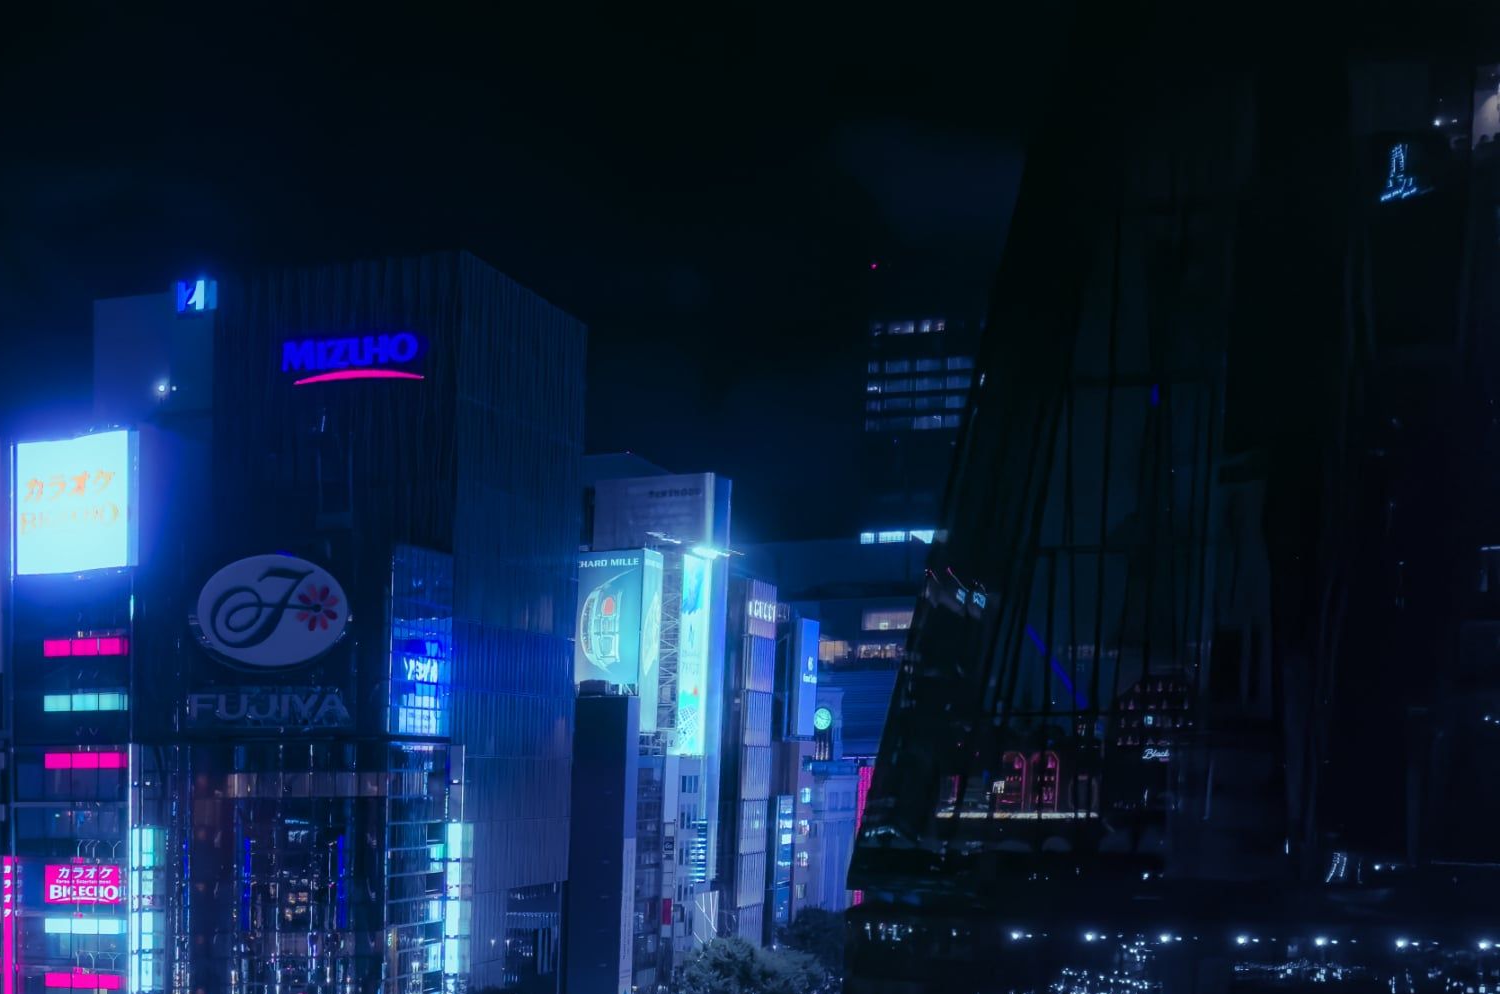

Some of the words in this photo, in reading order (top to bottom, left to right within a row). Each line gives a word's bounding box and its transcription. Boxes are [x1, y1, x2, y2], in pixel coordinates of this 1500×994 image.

[282, 332, 419, 371] MIZUHO
[22, 468, 116, 502] カラオケ
[610, 557, 640, 567] MILLE
[187, 692, 352, 721] FUJIYA
[58, 866, 113, 879] カラオケ
[49, 884, 77, 900] BIG
[78, 885, 119, 900] ECHO
